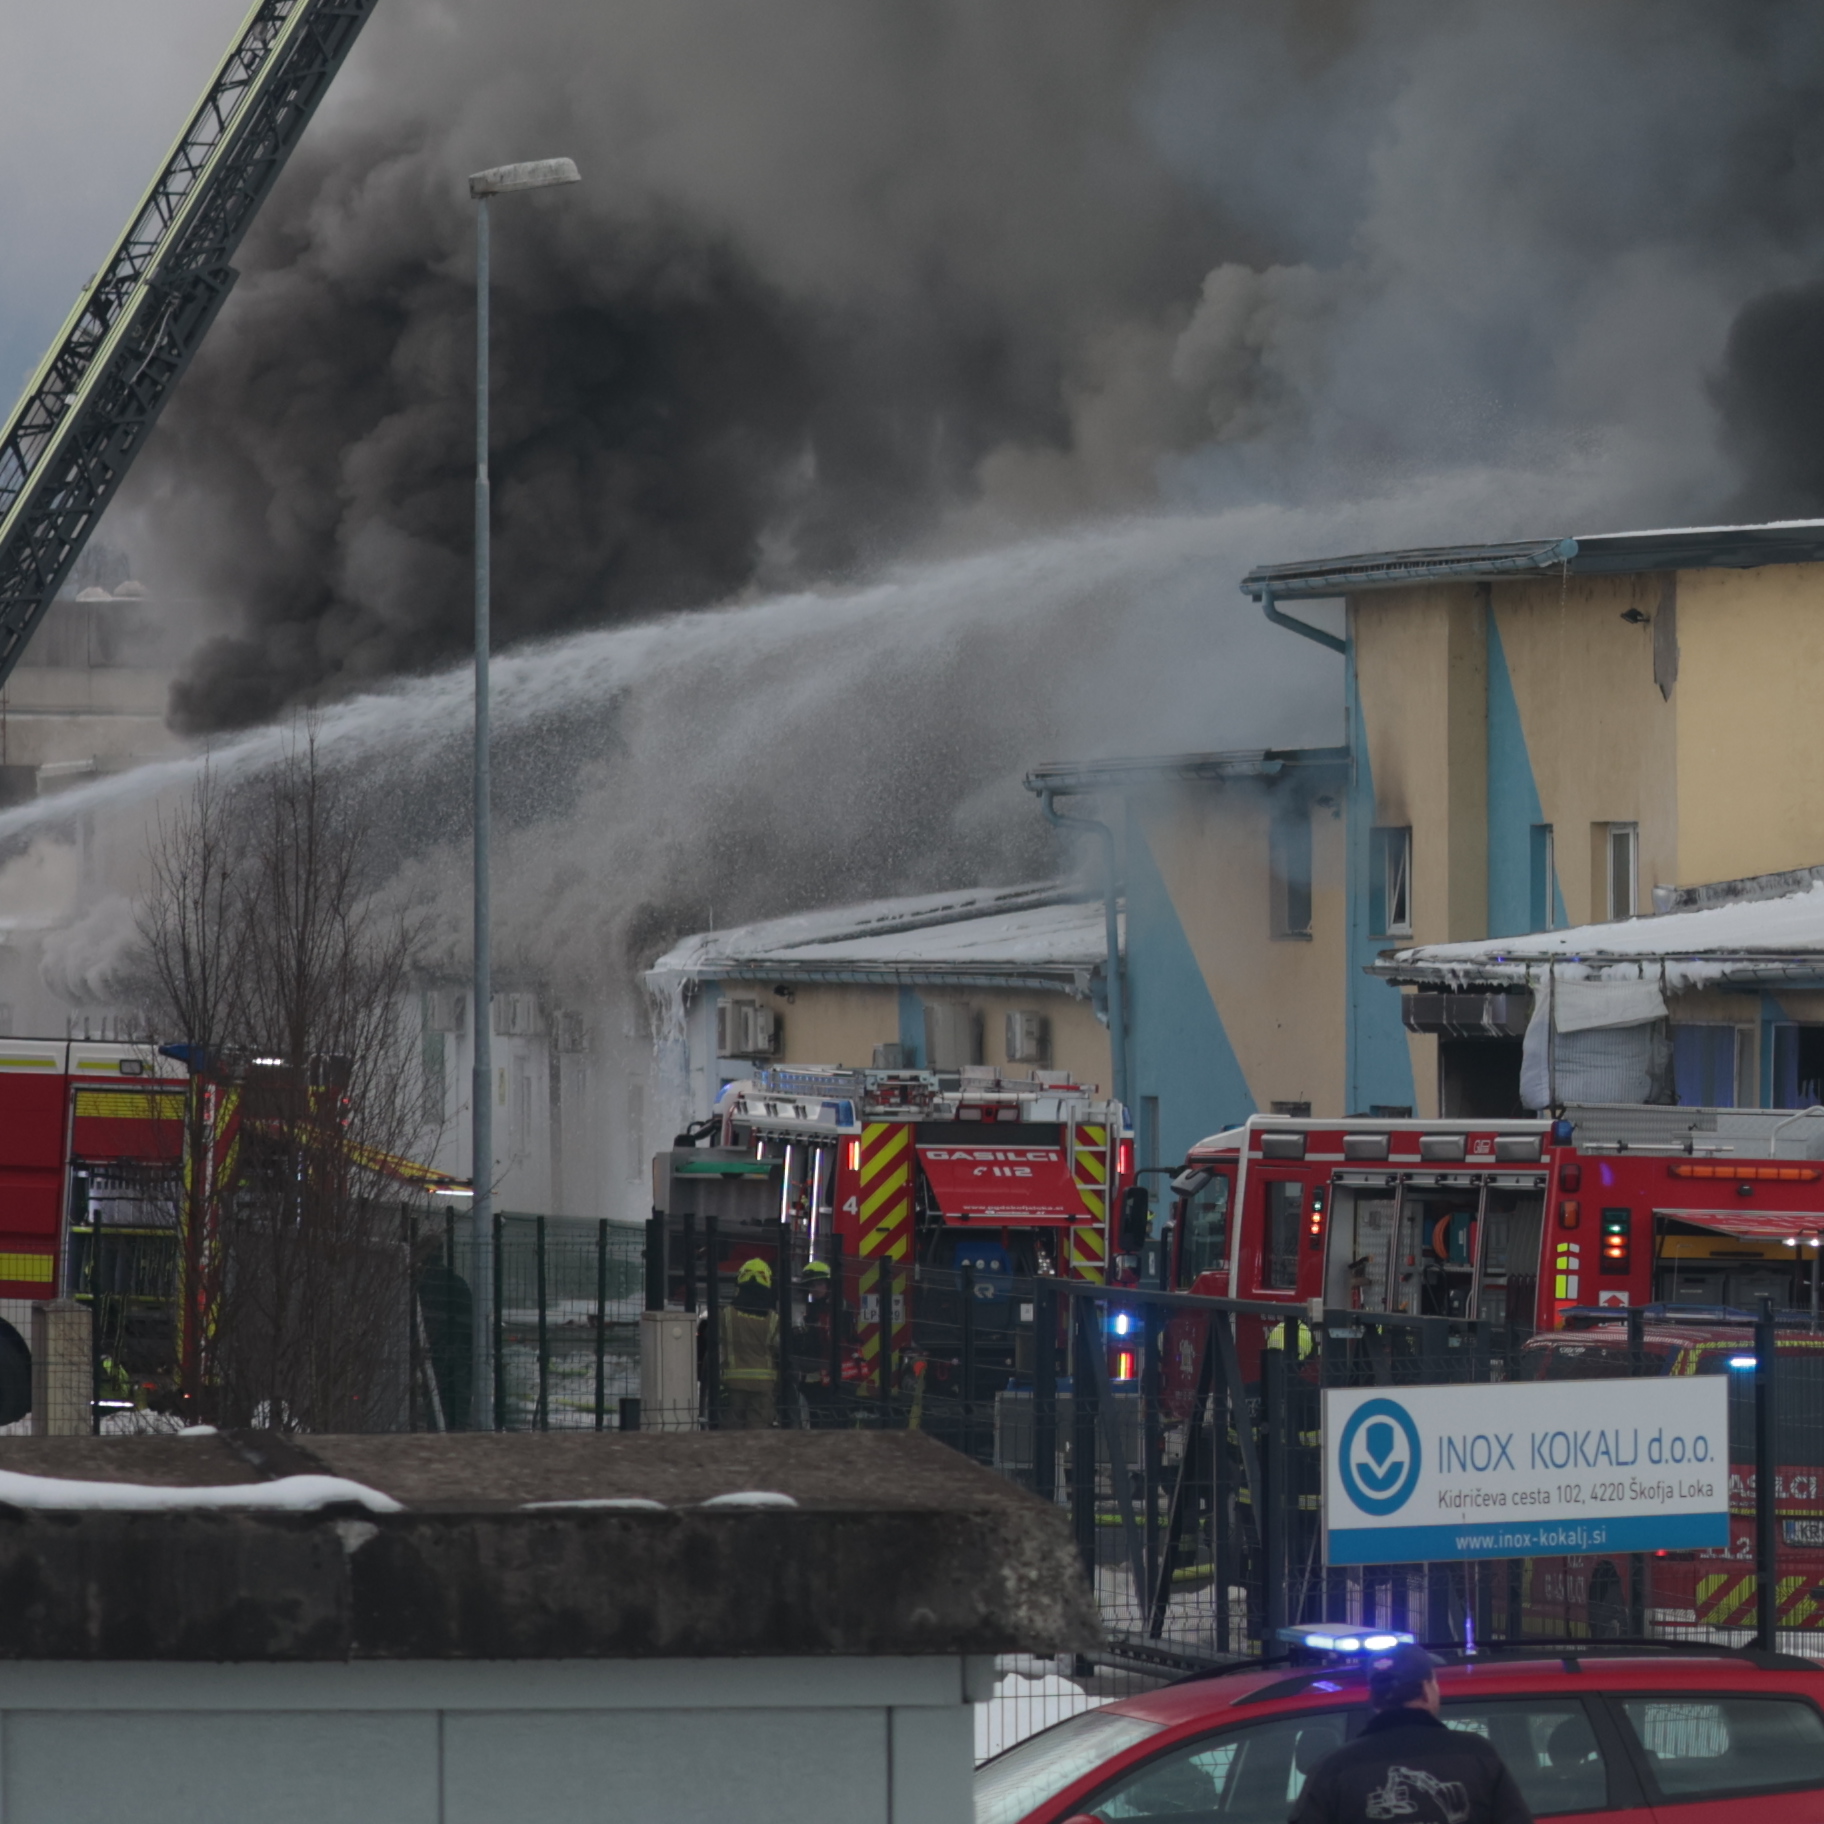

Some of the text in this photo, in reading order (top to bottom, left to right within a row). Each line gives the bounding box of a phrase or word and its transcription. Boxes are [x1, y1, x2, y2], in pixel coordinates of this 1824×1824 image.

[926, 1151, 1058, 1161] GASILCI
[993, 1167, 1032, 1177] 112
[843, 1196, 858, 1215] 4
[1439, 1427, 1714, 1474] INOX KOKALJ d.o.o.
[1439, 1477, 1714, 1508] Kidričeva cesta 102, 4220 Škofja Loka
[1456, 1526, 1606, 1550] www.inox-kokalj.si
